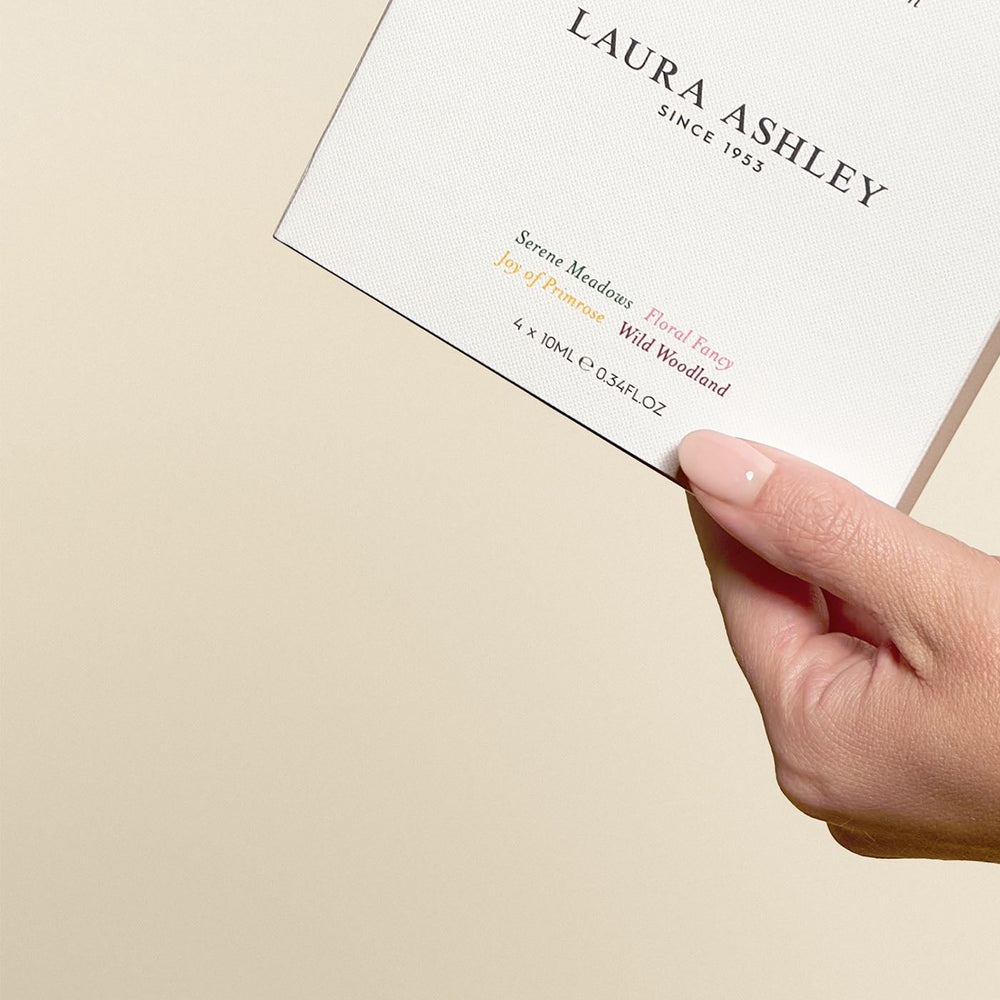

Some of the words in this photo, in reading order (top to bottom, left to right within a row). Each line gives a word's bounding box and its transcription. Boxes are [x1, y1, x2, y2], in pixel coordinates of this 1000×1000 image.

[567, 6, 704, 110] LAURA
[720, 103, 888, 208] ASHLEY
[658, 104, 715, 144] SINCE
[723, 142, 765, 173] 1953
[494, 250, 522, 275] Joy
[524, 270, 546, 288] of
[542, 277, 606, 323] Primrose
[515, 229, 564, 268] Serene
[565, 260, 634, 310] Meadows
[513, 317, 523, 331] 4
[526, 328, 538, 338] x
[540, 332, 573, 363] 10ML
[595, 366, 667, 417] 0.34FL.OZ
[619, 321, 656, 353] Wild
[656, 343, 732, 397] Woodland
[644, 307, 692, 343] Floral
[691, 335, 735, 371] Fancy
